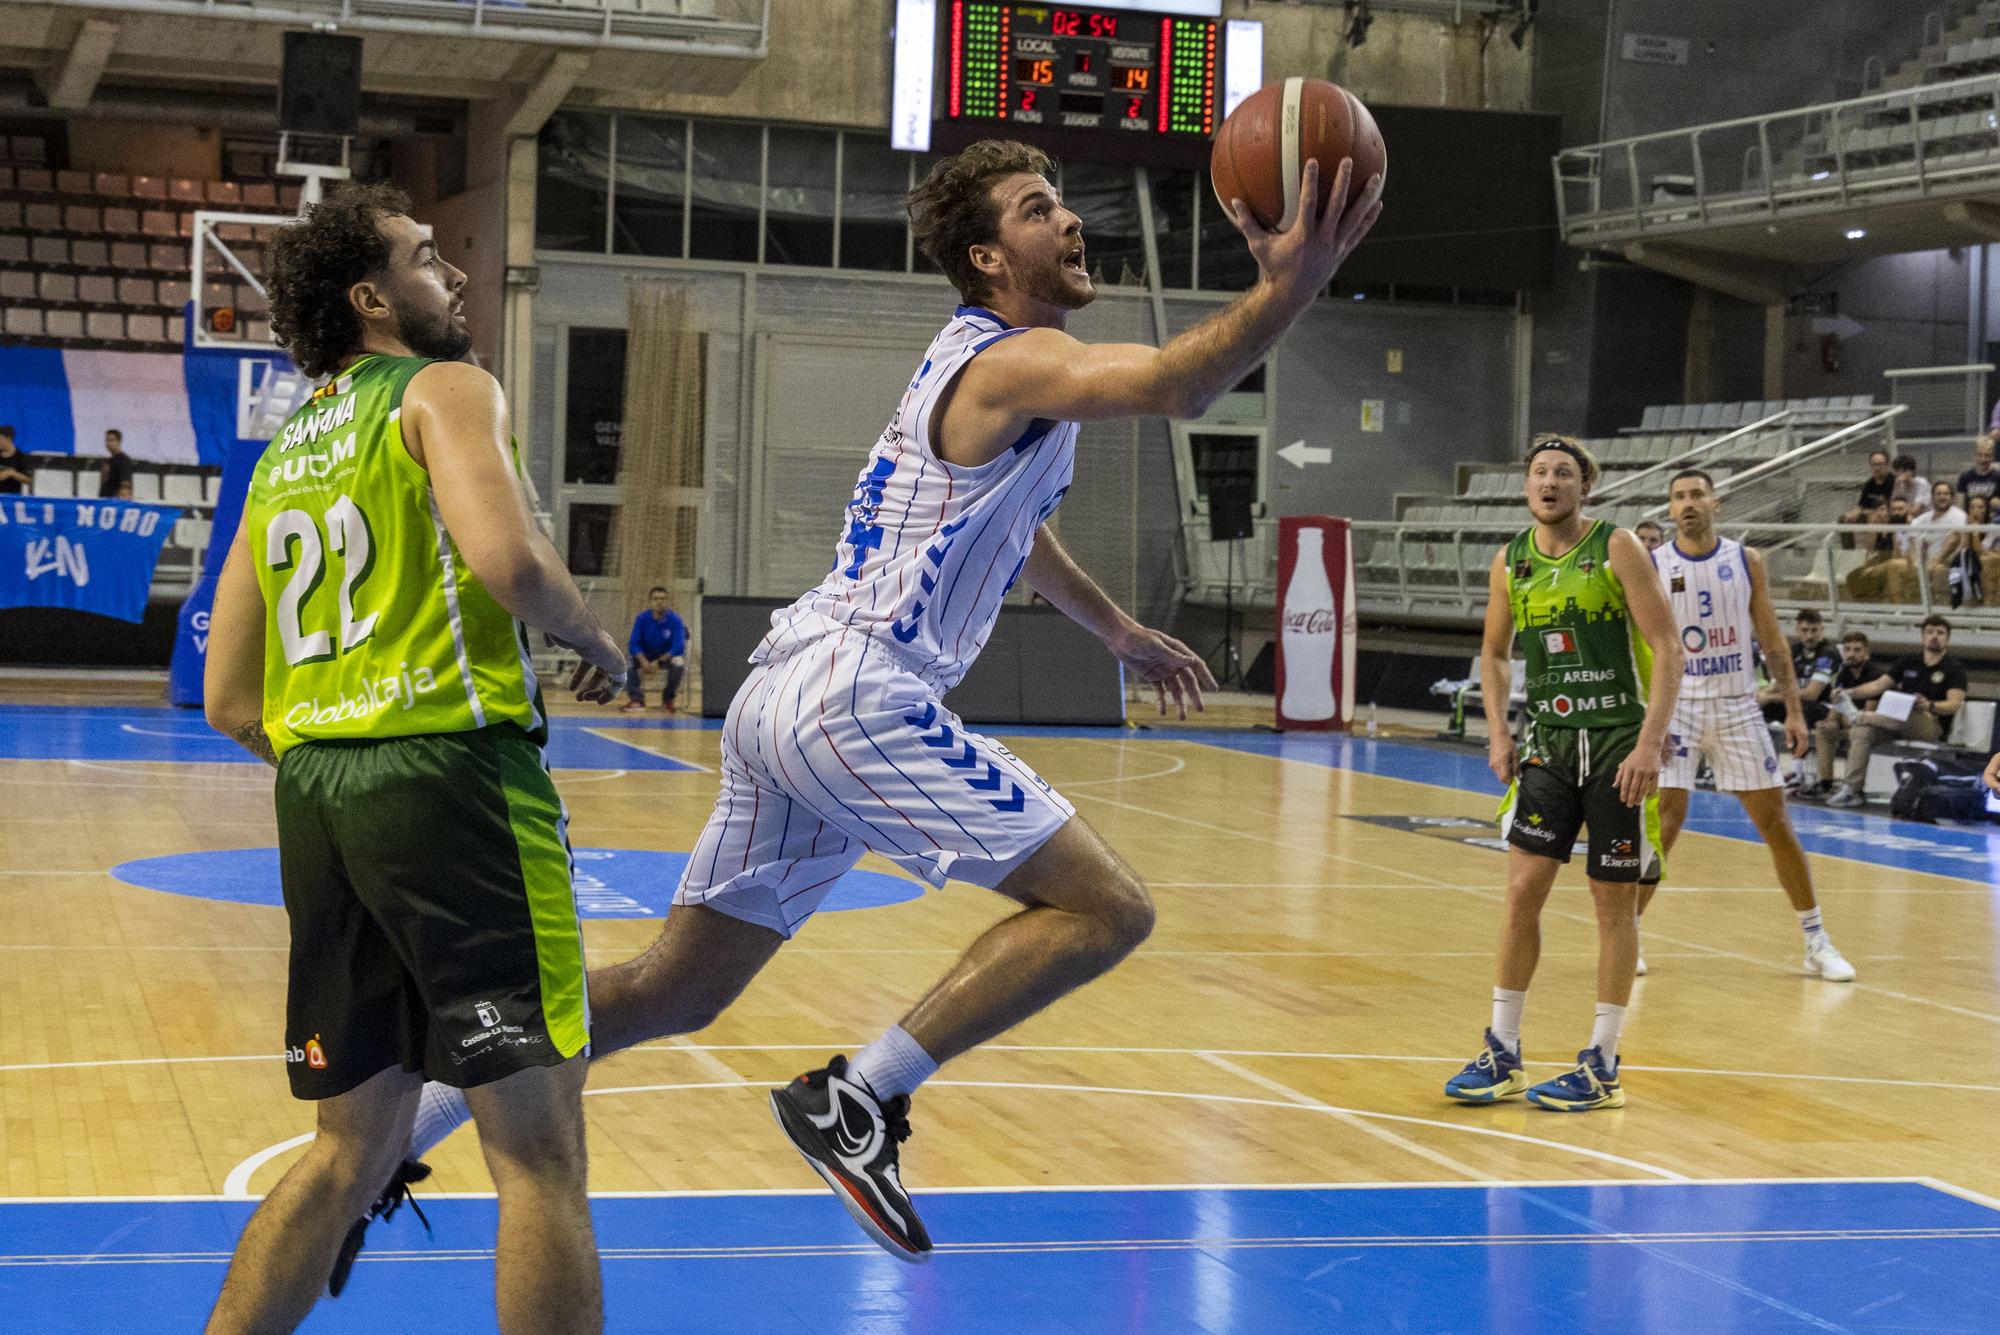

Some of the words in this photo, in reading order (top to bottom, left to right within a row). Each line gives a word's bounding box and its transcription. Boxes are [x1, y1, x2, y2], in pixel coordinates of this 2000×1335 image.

[1016, 39, 1056, 54] LOCAL
[1032, 59, 1054, 85] 15
[1126, 68, 1150, 89] 14
[1020, 90, 1036, 111] 2
[1127, 97, 1143, 119] 2
[266, 494, 381, 669] 22
[1696, 590, 1713, 618] 3
[1563, 669, 1616, 684] ARENAS
[283, 660, 438, 731] Globalcaja
